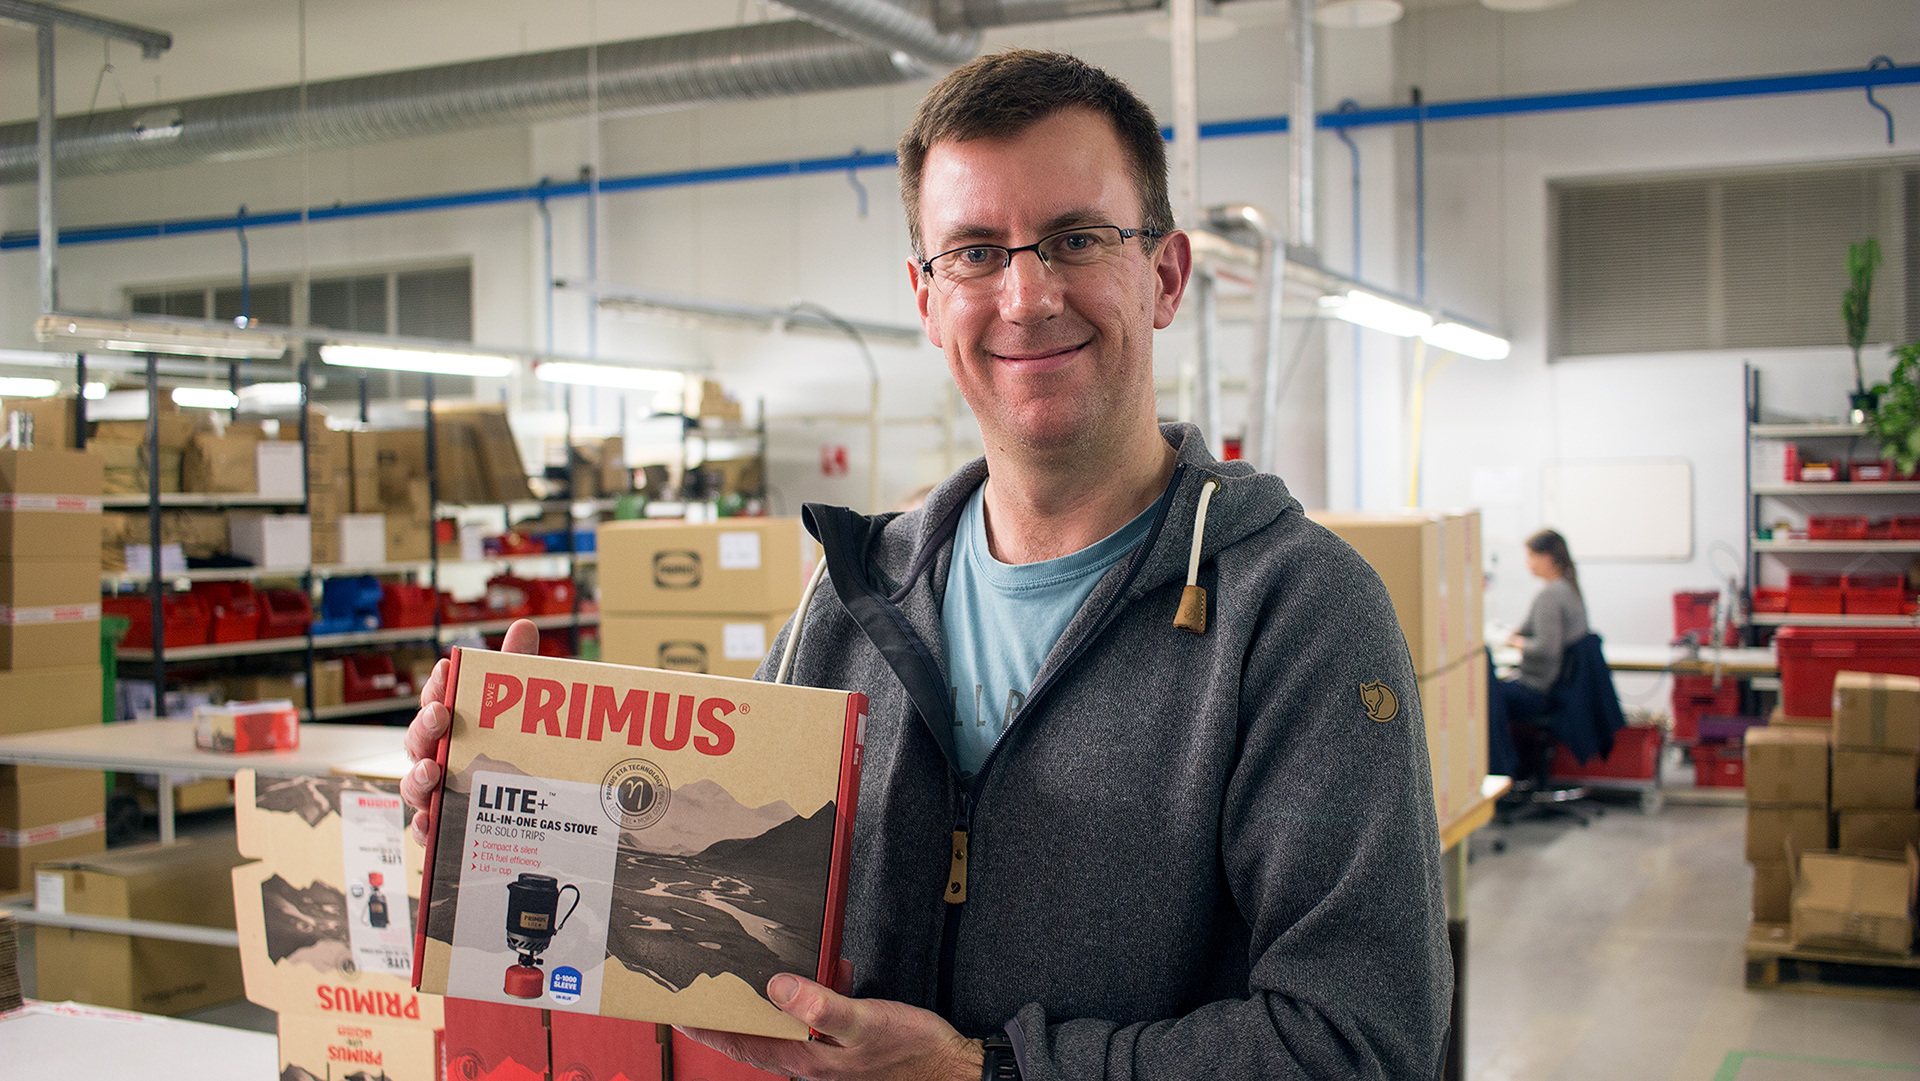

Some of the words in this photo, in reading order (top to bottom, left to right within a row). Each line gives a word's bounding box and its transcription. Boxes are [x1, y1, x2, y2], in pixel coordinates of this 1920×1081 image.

[485, 682, 496, 707] SWE
[606, 775, 618, 800] PRIMUS
[628, 764, 664, 787] TECHNOLOGY
[475, 823, 493, 835] FOR
[495, 826, 518, 838] SOLO
[521, 829, 546, 842] TRIPS
[476, 811, 538, 828] ALL-IN-ONE
[540, 819, 562, 831] GAS
[564, 822, 598, 836] STOVE
[482, 840, 512, 852] Compact
[513, 844, 519, 853] &
[520, 845, 538, 856] silent
[479, 863, 490, 873] Lid
[498, 867, 512, 876] cup
[480, 851, 495, 862] ETA
[496, 853, 508, 864] fuel
[509, 856, 541, 868] efficiency
[553, 980, 578, 990] SLEEVE
[316, 984, 421, 1021] PRIMUS
[327, 1044, 383, 1067] PRIMUS
